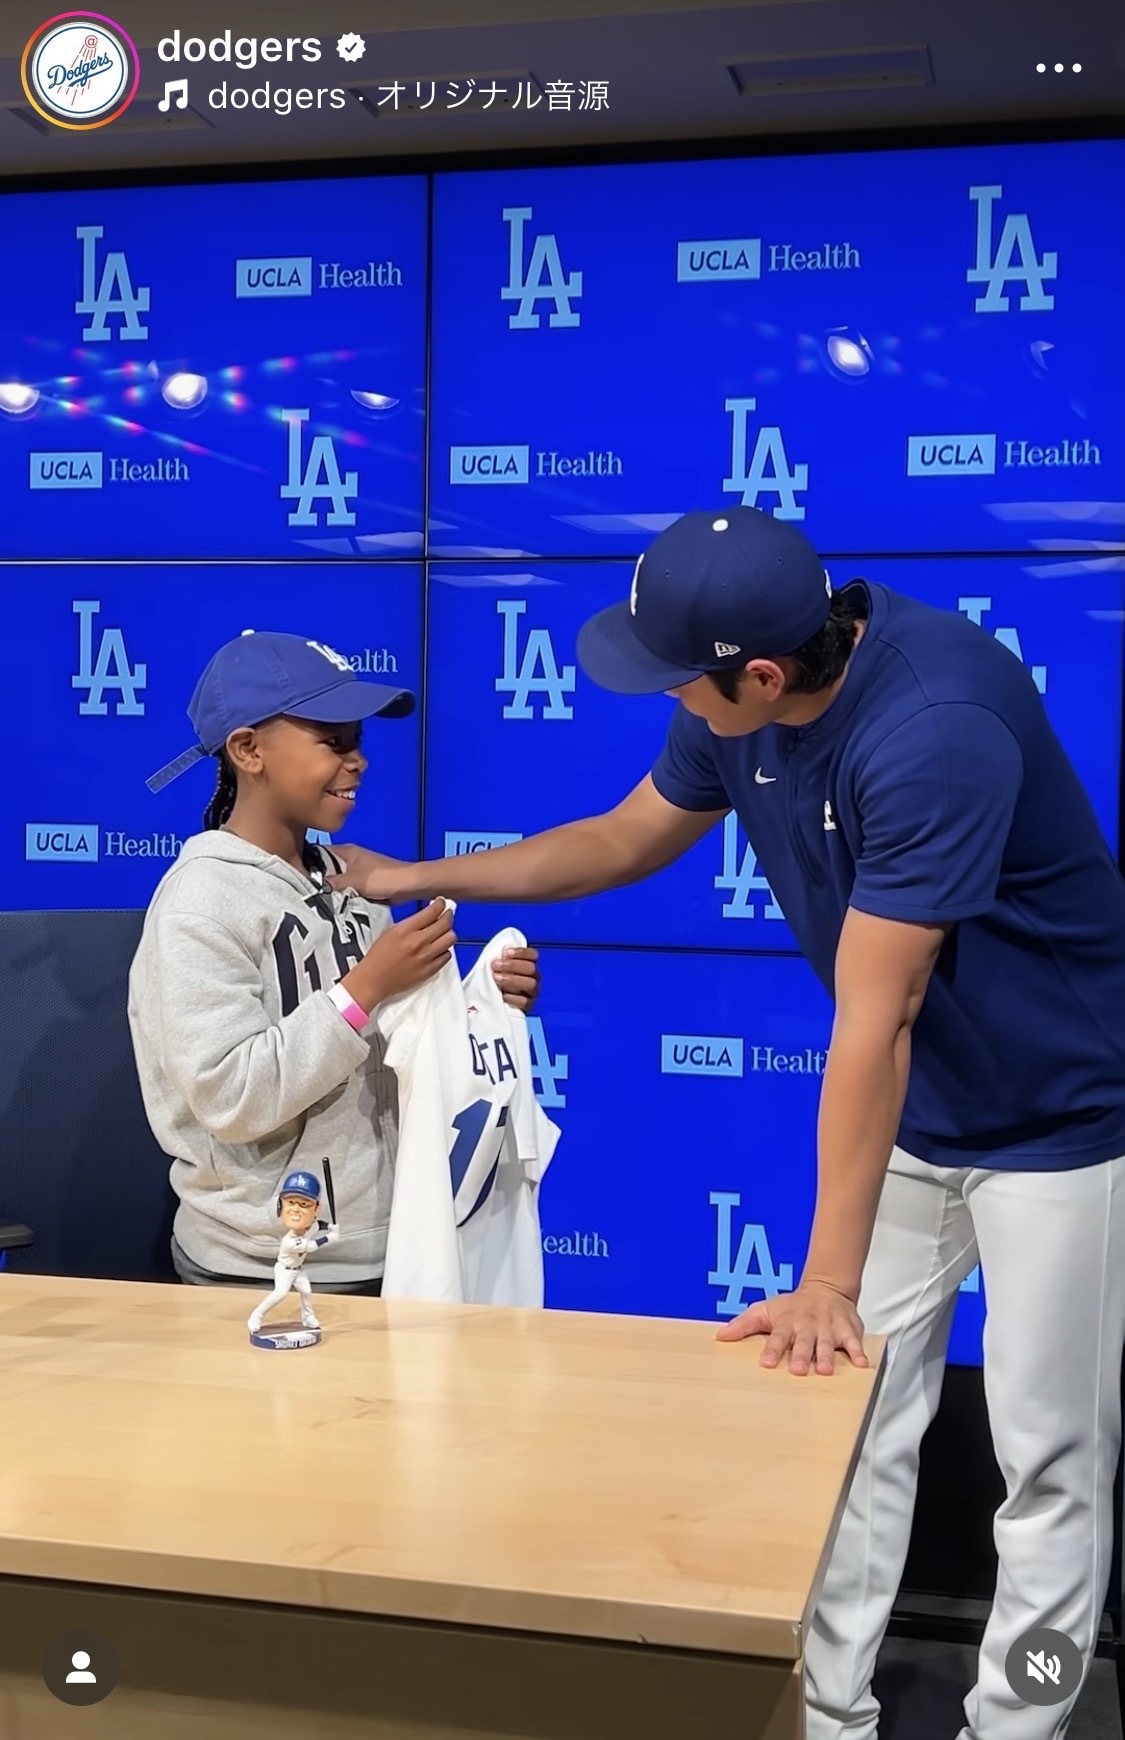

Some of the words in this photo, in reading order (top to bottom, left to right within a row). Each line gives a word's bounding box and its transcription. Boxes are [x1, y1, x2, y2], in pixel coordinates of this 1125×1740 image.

[75, 225, 151, 342] LA
[246, 266, 302, 289] UCLA
[319, 261, 403, 290] Health
[501, 207, 583, 330] LA
[689, 249, 750, 273] UCLA
[768, 242, 861, 272] Health
[967, 185, 1058, 313] LA
[40, 460, 94, 481] UCLA
[109, 457, 190, 482] Health
[280, 408, 359, 527] LA
[461, 454, 519, 476] UCLA
[536, 451, 623, 477] Health
[723, 397, 809, 520] LA
[920, 444, 984, 467] UCLA
[1003, 439, 1102, 468] Health
[72, 600, 147, 716] LA
[496, 600, 576, 720] LA
[36, 832, 90, 853] UCLA
[673, 1044, 733, 1068] UCLA
[750, 1046, 831, 1076] Healt
[542, 1229, 610, 1258] ealth
[708, 1191, 793, 1314] LA
